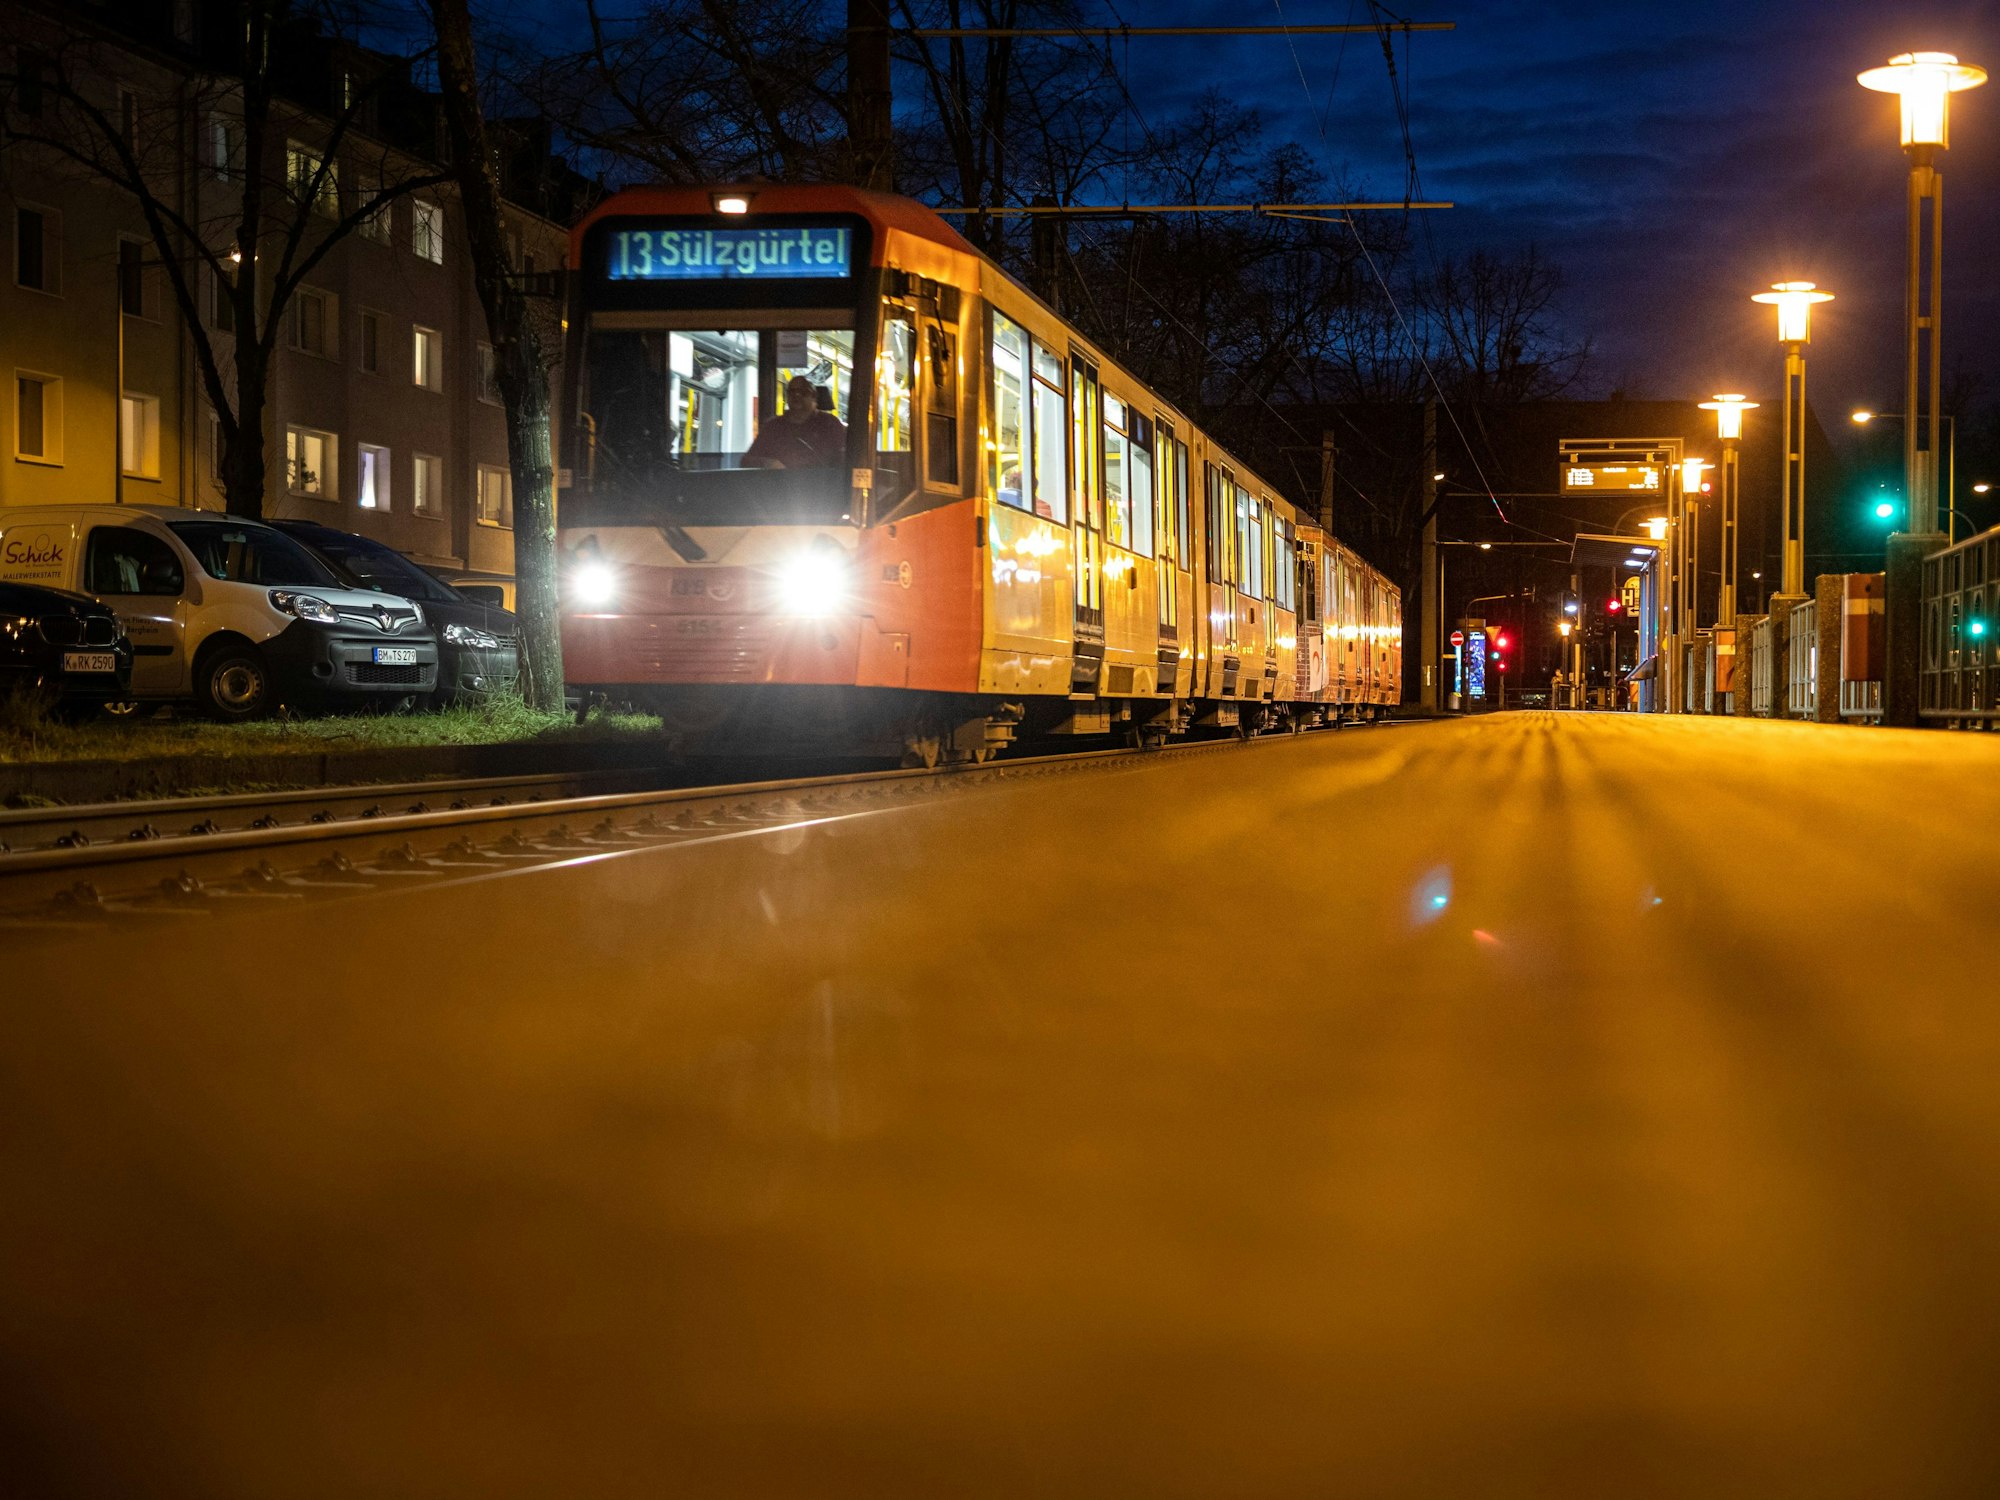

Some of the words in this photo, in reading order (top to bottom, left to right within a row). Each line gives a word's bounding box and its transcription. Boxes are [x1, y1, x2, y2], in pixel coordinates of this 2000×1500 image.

[618, 231, 652, 275] 13
[660, 229, 845, 274] Sülzgürtel
[6, 541, 63, 564] Schick
[1621, 589, 1634, 606] H
[65, 655, 72, 670] K
[78, 655, 91, 670] RK
[91, 655, 114, 670] 2590
[392, 650, 402, 661] TS
